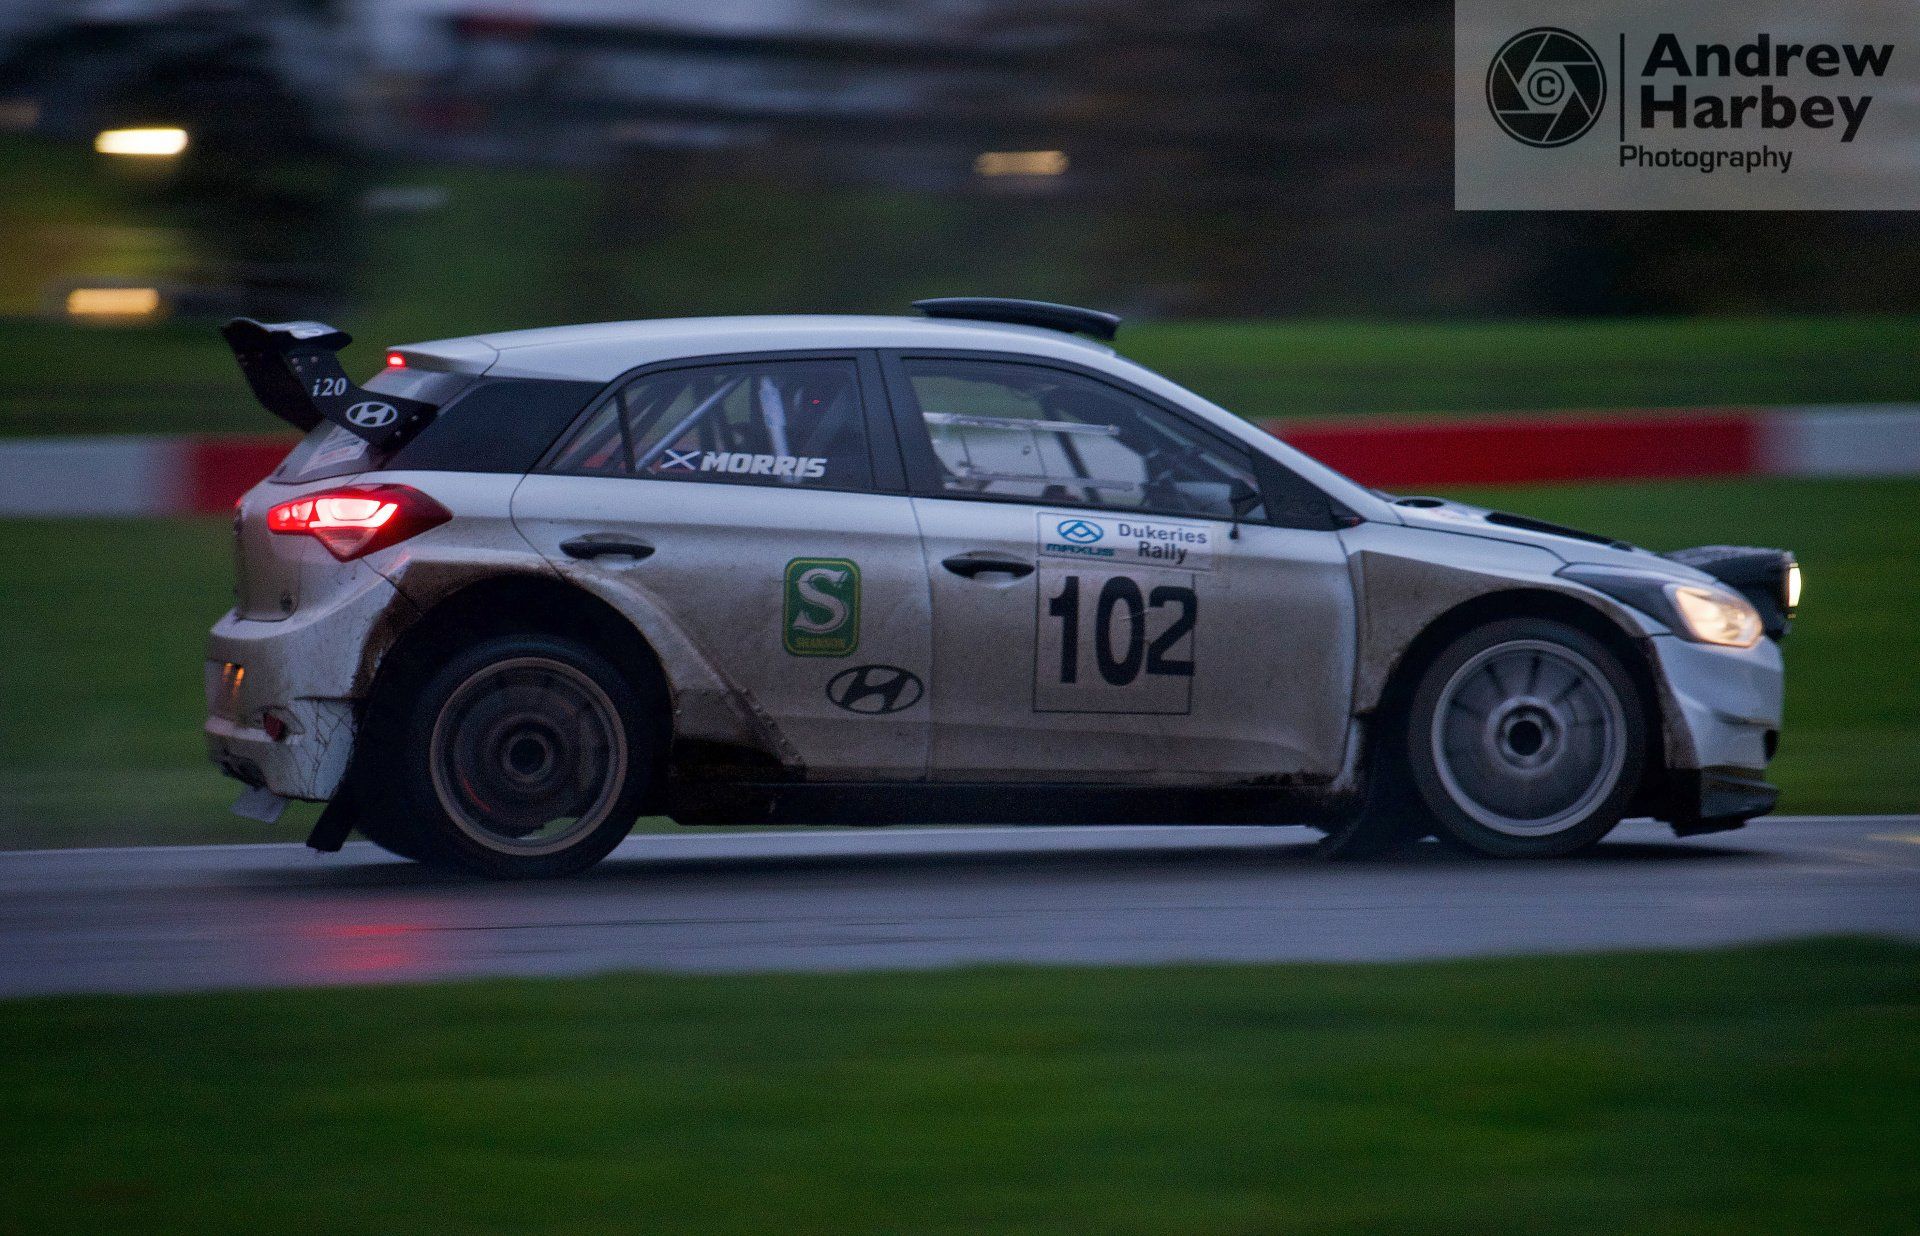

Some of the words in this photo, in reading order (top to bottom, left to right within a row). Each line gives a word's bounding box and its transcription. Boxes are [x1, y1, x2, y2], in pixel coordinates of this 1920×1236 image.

[312, 376, 348, 398] i20
[700, 450, 827, 478] MORRIS
[1118, 523, 1208, 544] Dukeries
[1138, 541, 1188, 565] Rally
[1049, 576, 1198, 686] 102
